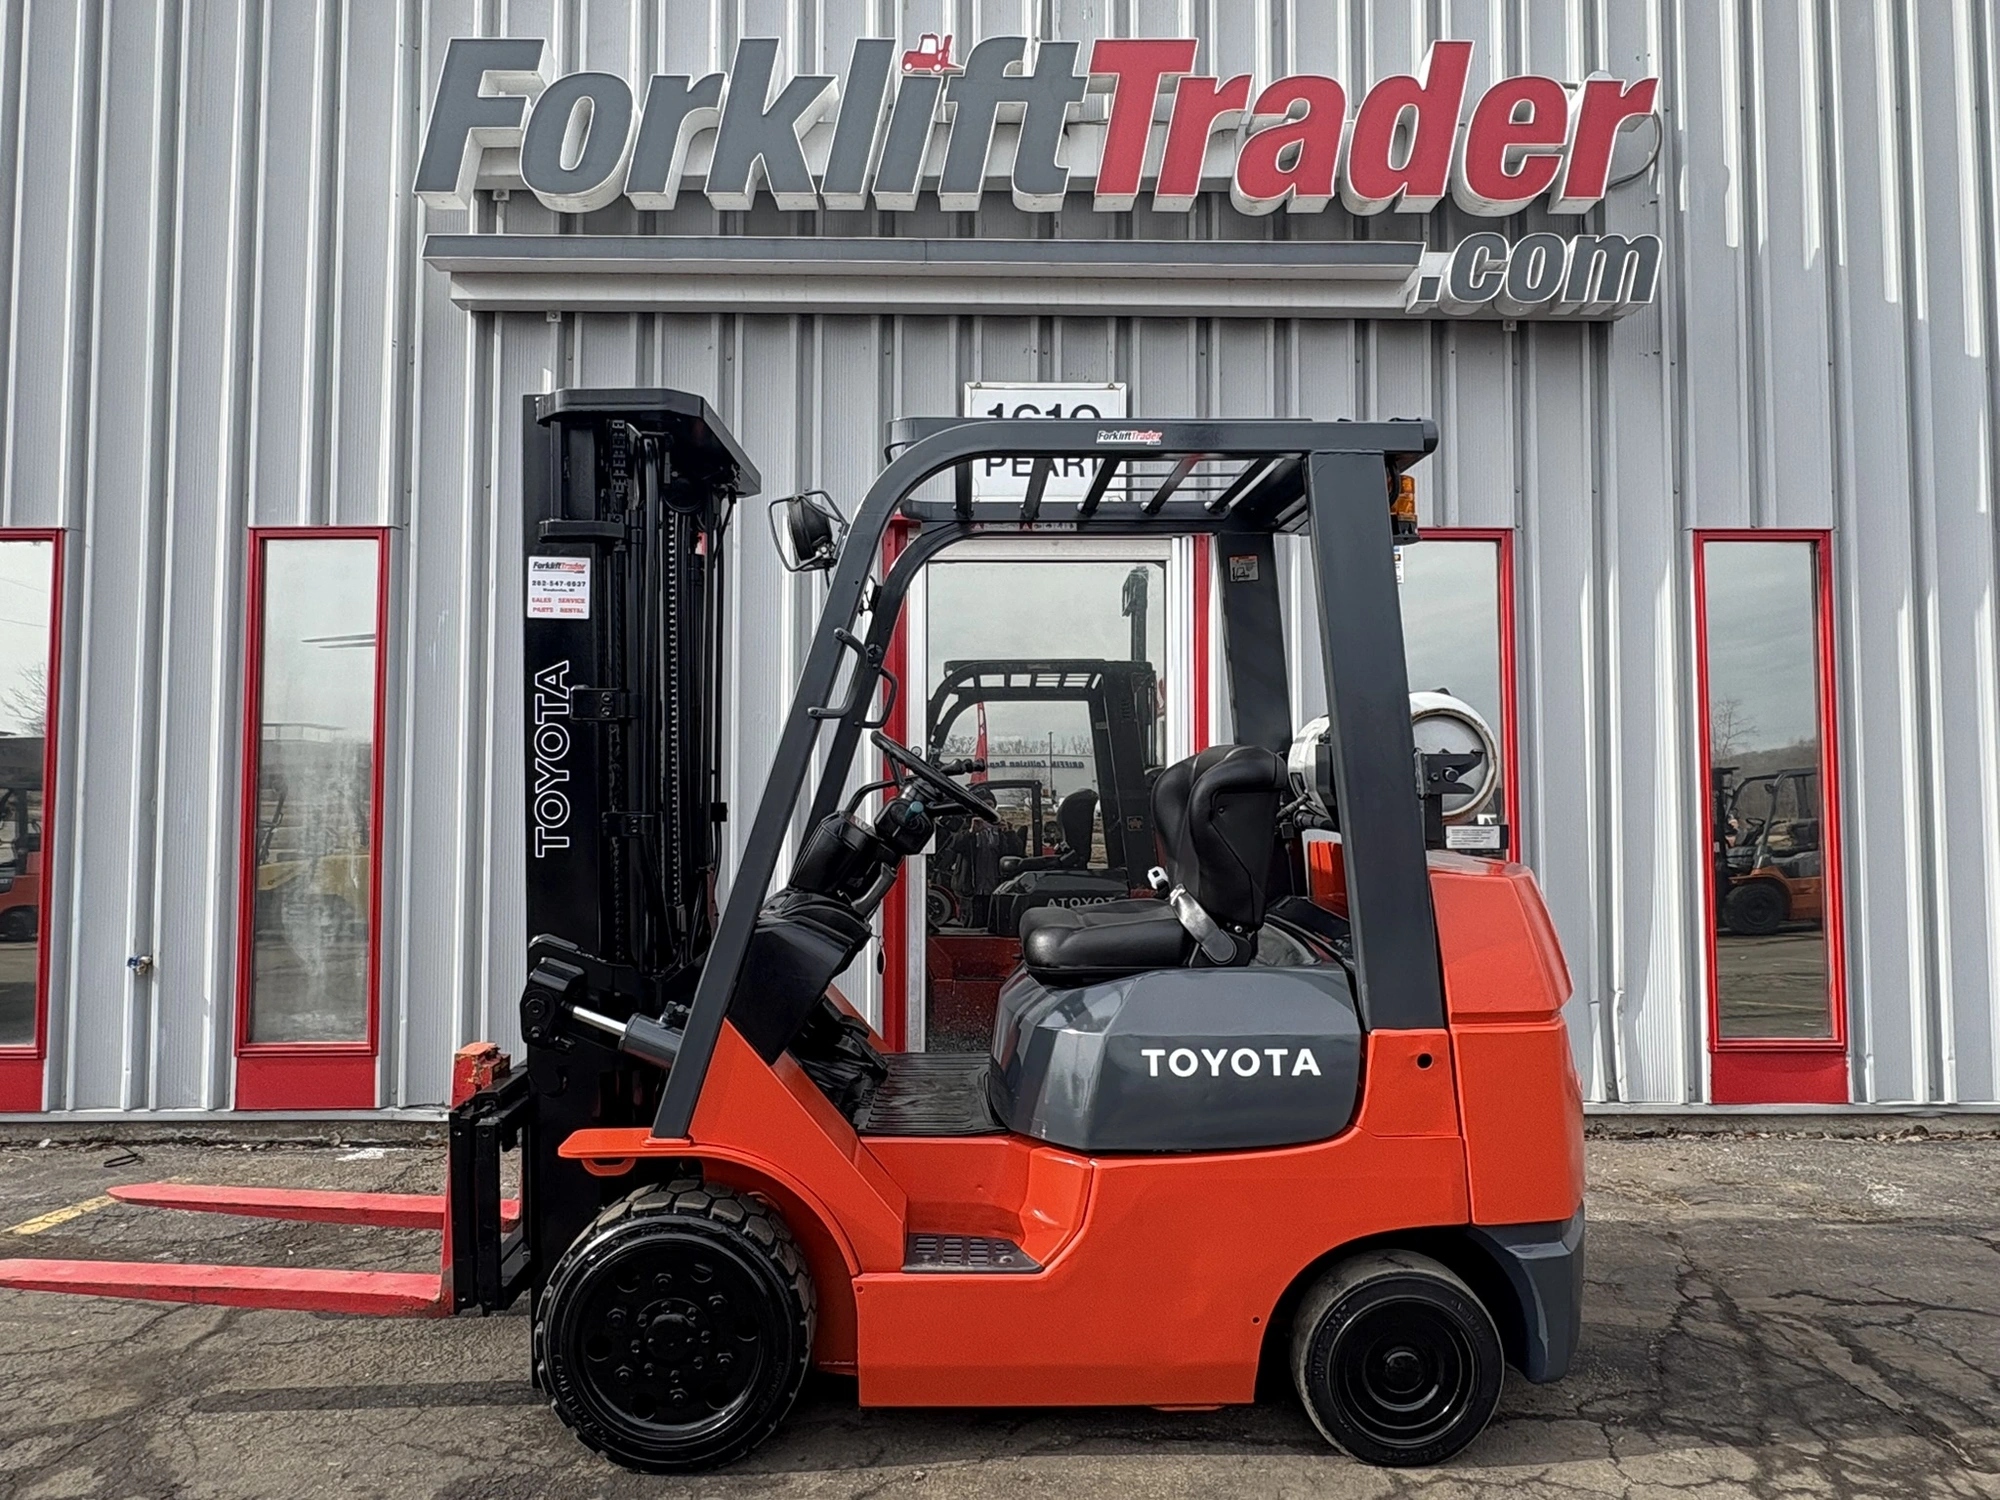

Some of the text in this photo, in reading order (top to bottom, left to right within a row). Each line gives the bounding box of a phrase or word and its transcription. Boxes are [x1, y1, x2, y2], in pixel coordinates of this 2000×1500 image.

[414, 36, 1658, 204] ForkliftTrader
[1416, 232, 1662, 304] .com
[1098, 430, 1162, 441] ForkliftTrader
[534, 660, 570, 858] TOYOTA
[1141, 1048, 1322, 1077] TOYOTA
